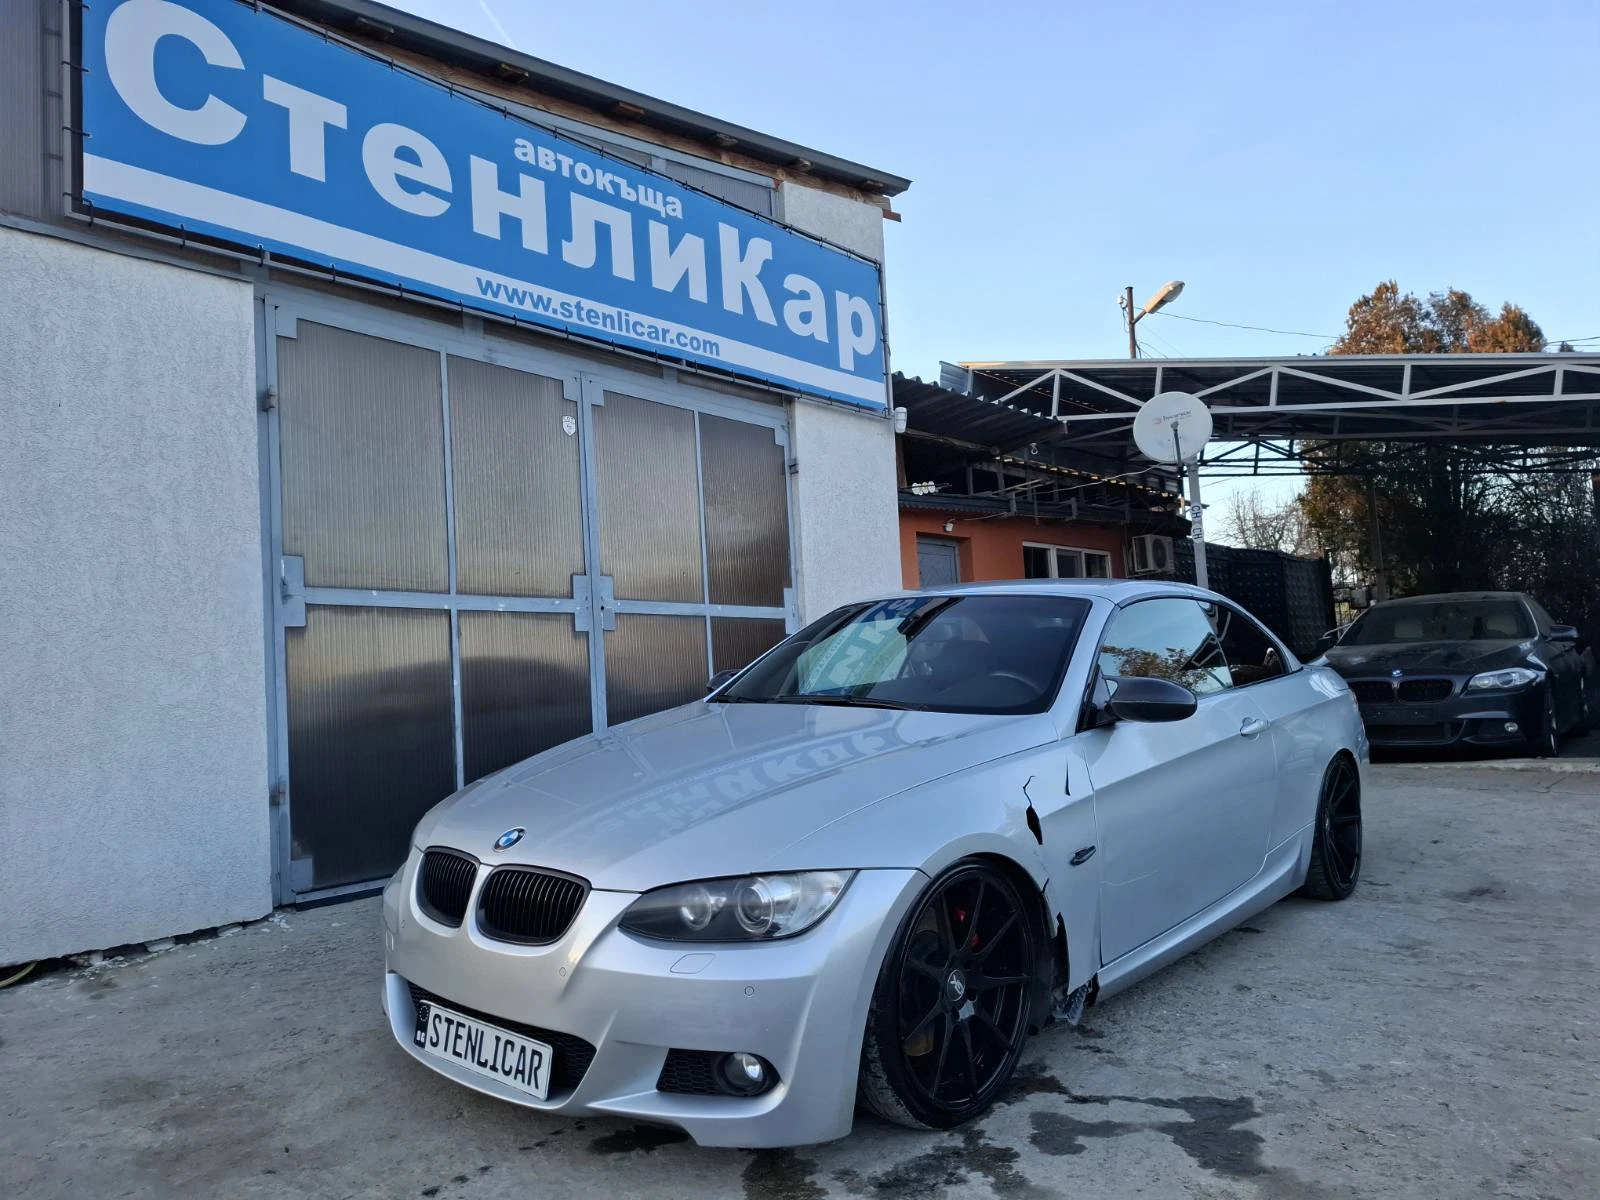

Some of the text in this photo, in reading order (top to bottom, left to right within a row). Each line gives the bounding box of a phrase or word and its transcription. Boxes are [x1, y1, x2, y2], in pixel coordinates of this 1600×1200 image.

[105, 0, 876, 371] СтенлиКар
[514, 138, 683, 219] автокъща
[476, 276, 721, 357] www.stenlicar.com
[430, 1013, 543, 1090] STENLICAR
